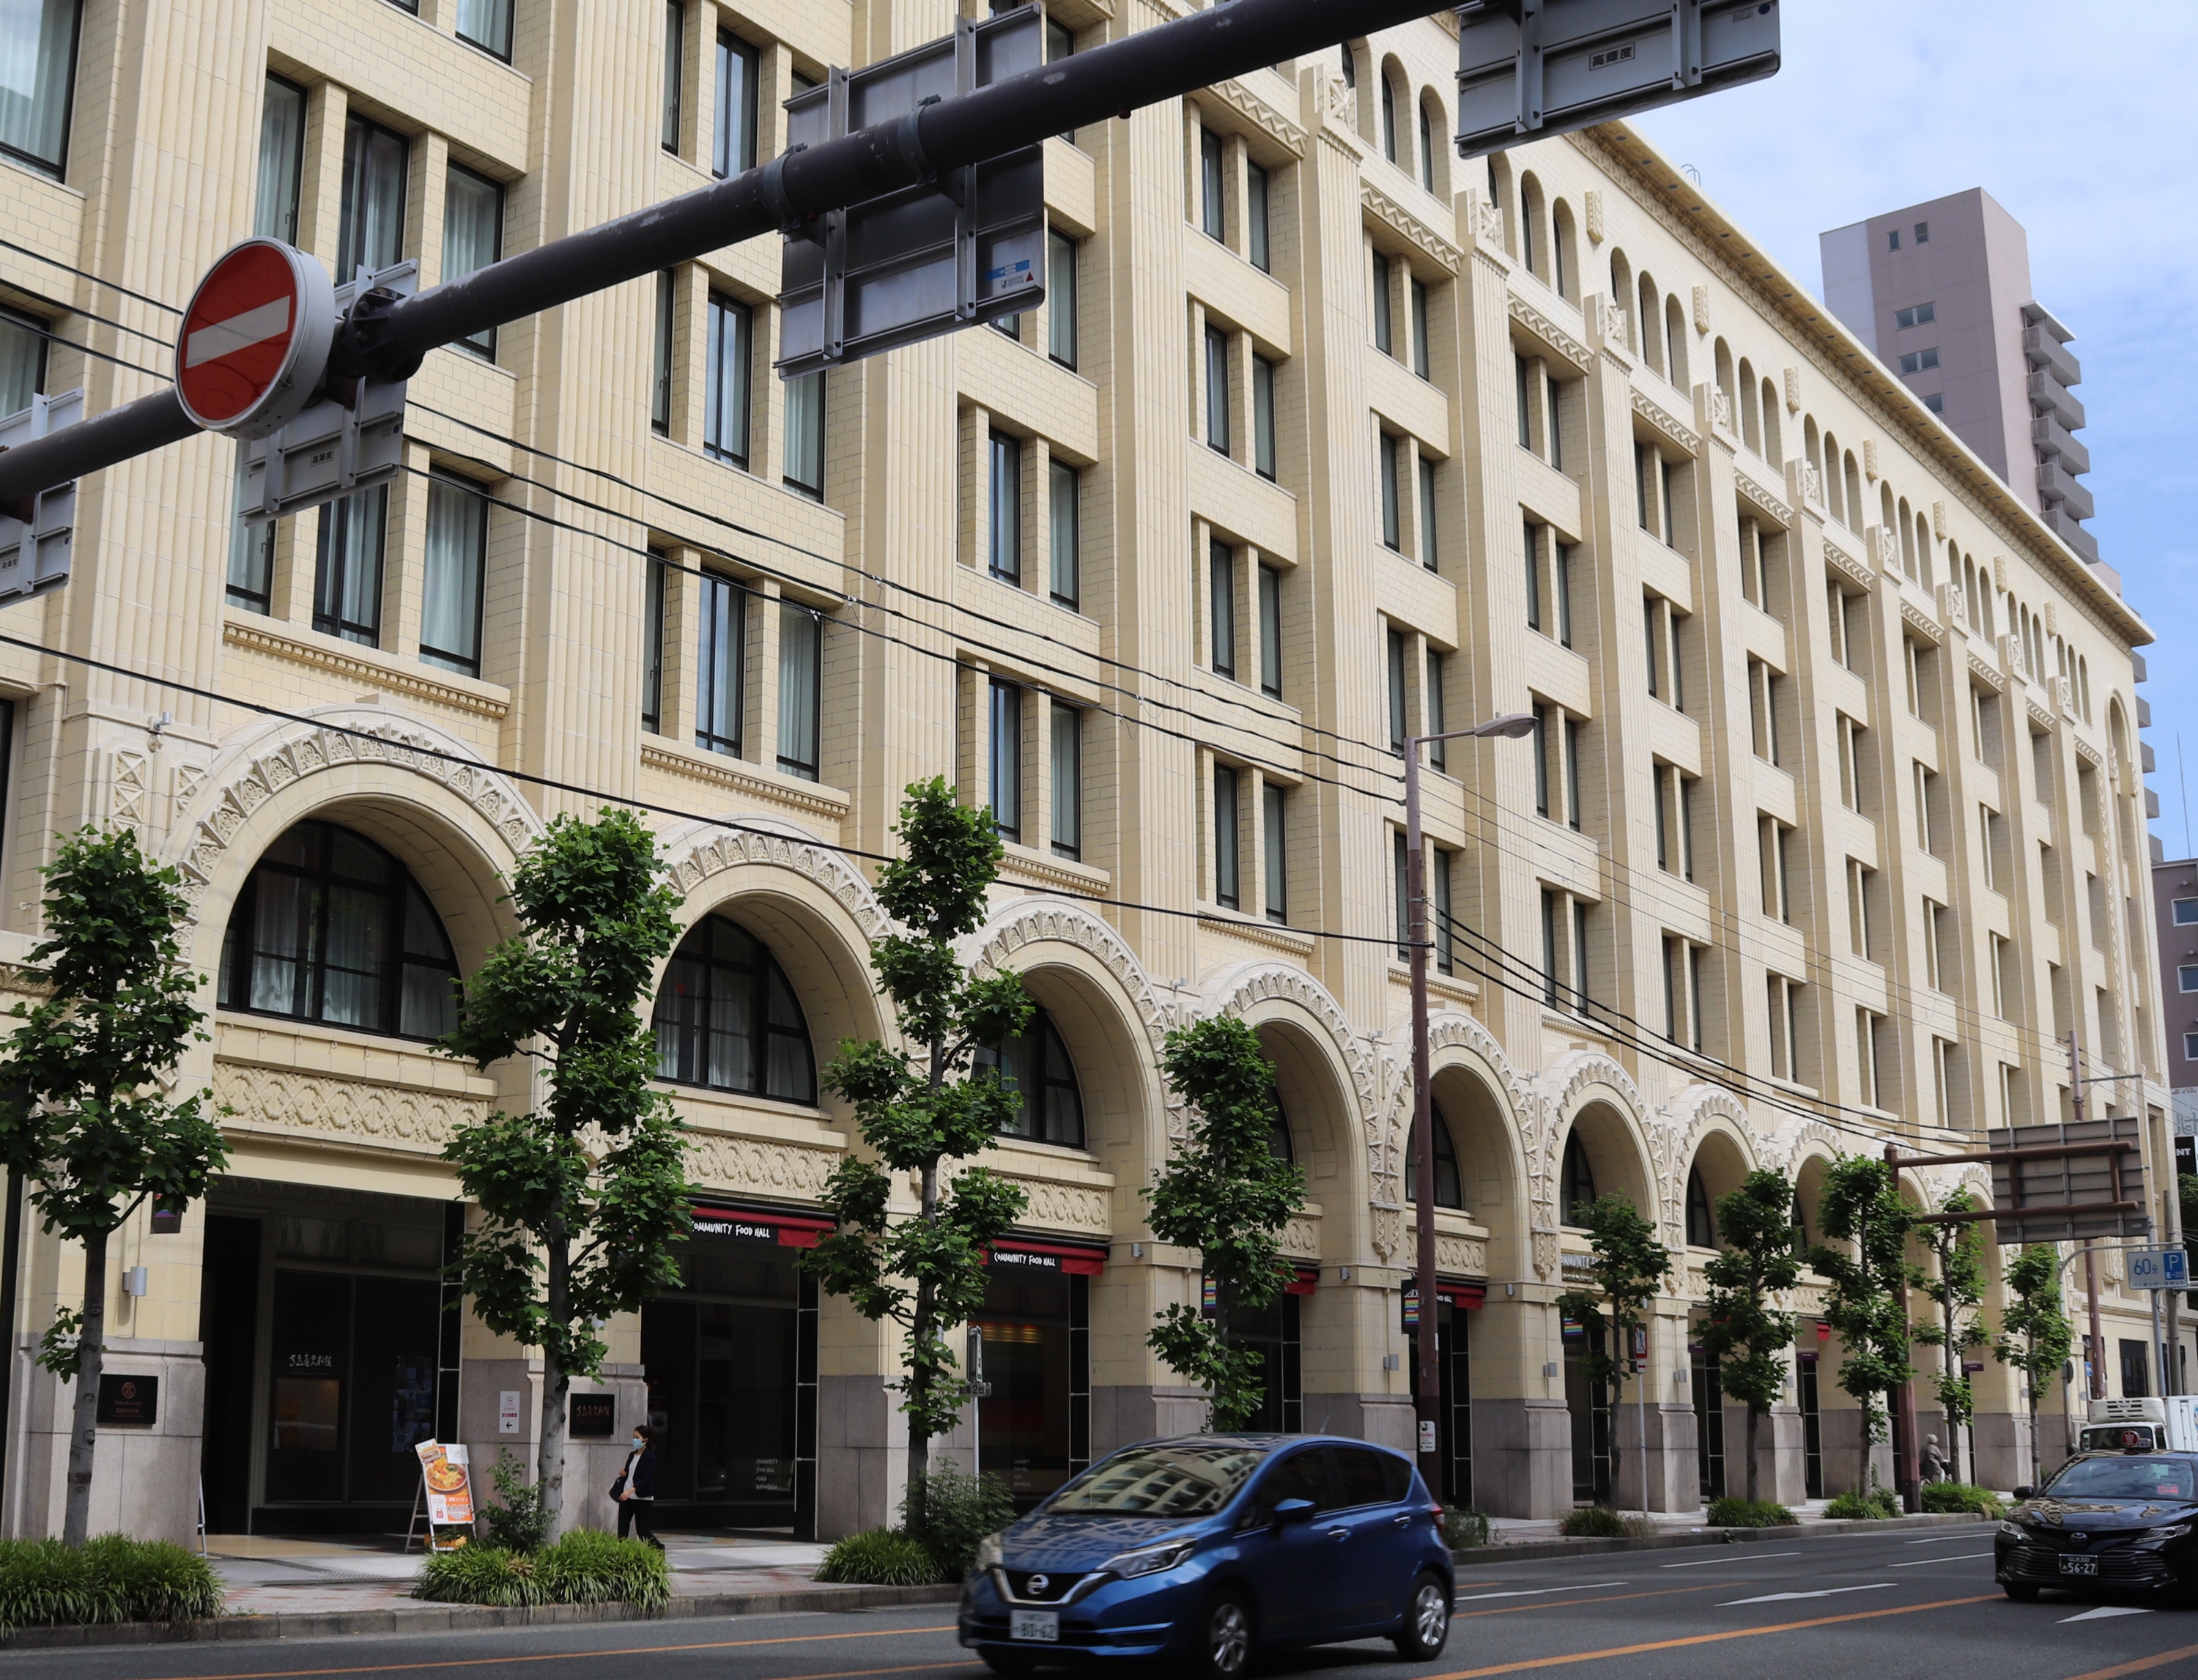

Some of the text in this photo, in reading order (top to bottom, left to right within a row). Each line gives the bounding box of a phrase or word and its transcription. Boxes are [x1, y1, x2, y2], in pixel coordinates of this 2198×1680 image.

[1592, 46, 1632, 67] 高輝度
[735, 1224, 753, 1237] FOOD
[754, 1227, 771, 1238] HALL
[993, 1251, 1056, 1267] COMMUNITY FOOD HALL
[2169, 1254, 2179, 1270] P
[2166, 1270, 2183, 1279] 8-20
[2068, 1563, 2096, 1574] 56-27
